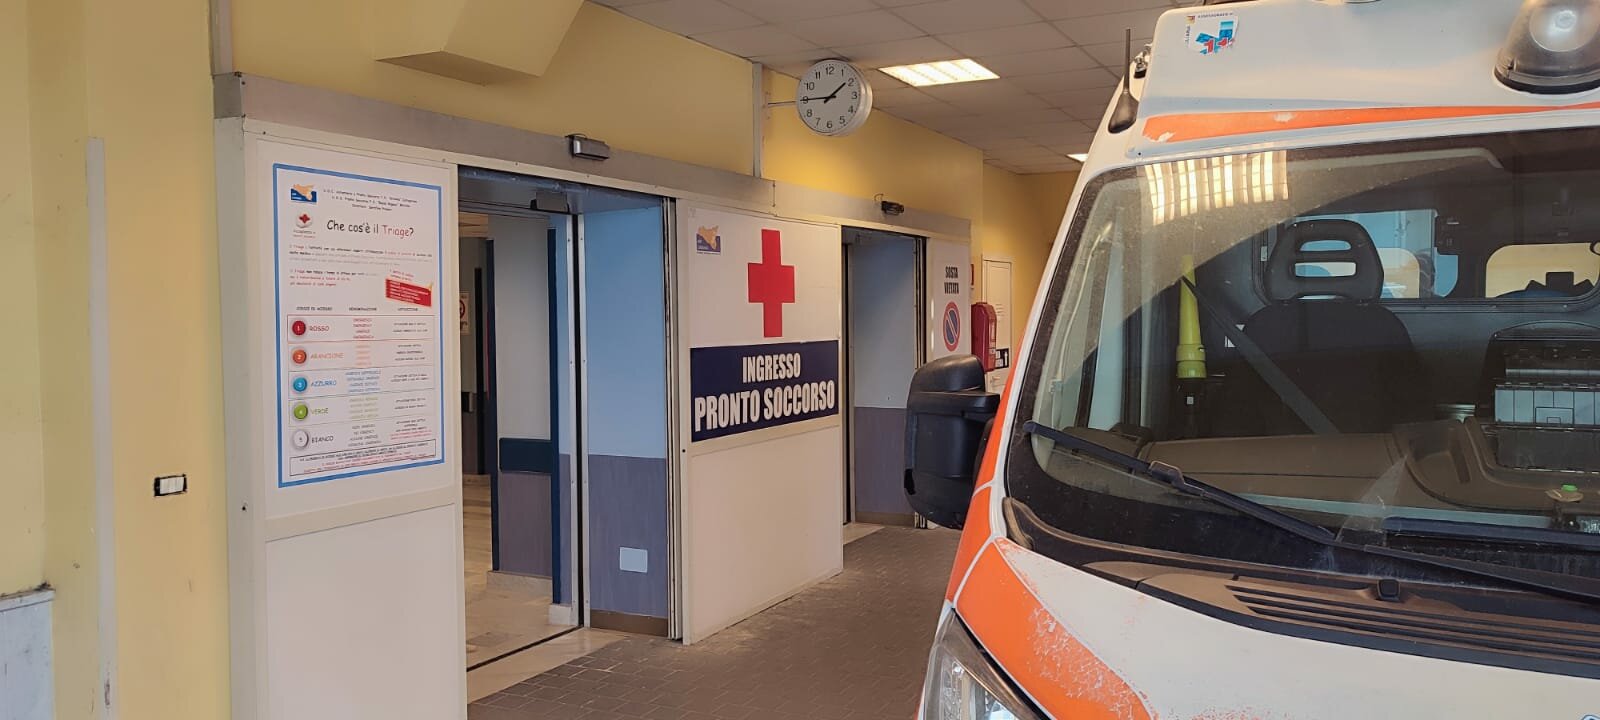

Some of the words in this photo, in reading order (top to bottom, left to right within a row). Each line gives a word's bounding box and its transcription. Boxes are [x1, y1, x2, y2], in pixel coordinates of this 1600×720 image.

[825, 66, 835, 75] 12
[841, 69, 844, 77] 1
[815, 71, 820, 79] 11
[847, 77, 855, 87] 2
[805, 82, 815, 91] 10
[851, 91, 858, 99] 3
[802, 96, 808, 104] 9
[806, 109, 812, 117] 8
[847, 105, 854, 113] 4
[815, 117, 821, 126] 7
[826, 120, 832, 128] 6
[839, 116, 845, 124] 5
[327, 219, 345, 231] Che
[373, 223, 379, 234] il
[381, 224, 414, 239] Triage?
[945, 266, 958, 279] SOSTA
[944, 282, 959, 295] VIETATA
[310, 352, 344, 360] ARANCIONE
[742, 352, 801, 384] INGRESSO
[694, 388, 760, 433] PRONTO
[763, 379, 836, 421] SOCCORSO
[311, 435, 334, 443] BIANCO
